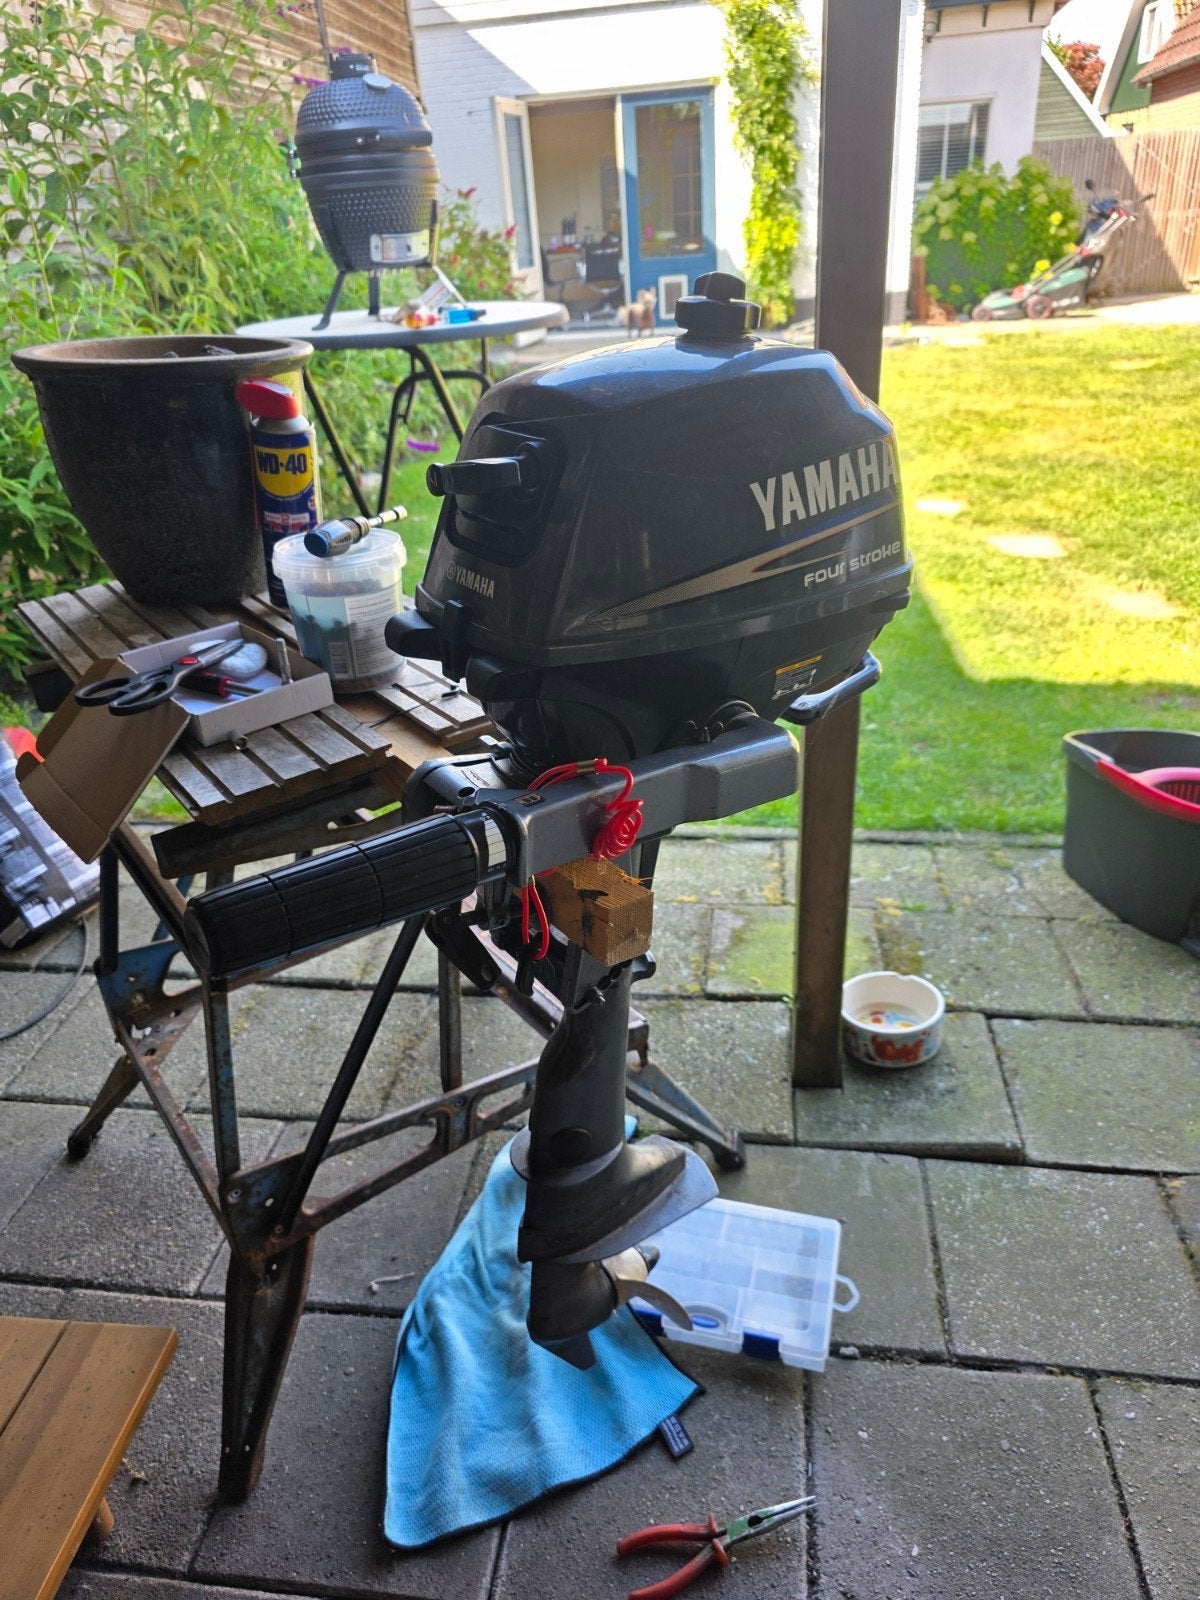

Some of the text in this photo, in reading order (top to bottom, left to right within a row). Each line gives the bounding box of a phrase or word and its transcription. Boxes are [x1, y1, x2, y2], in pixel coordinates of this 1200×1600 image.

[256, 451, 307, 475] WD-40
[750, 441, 899, 531] YAMAHA
[456, 565, 495, 599] YAMAHA
